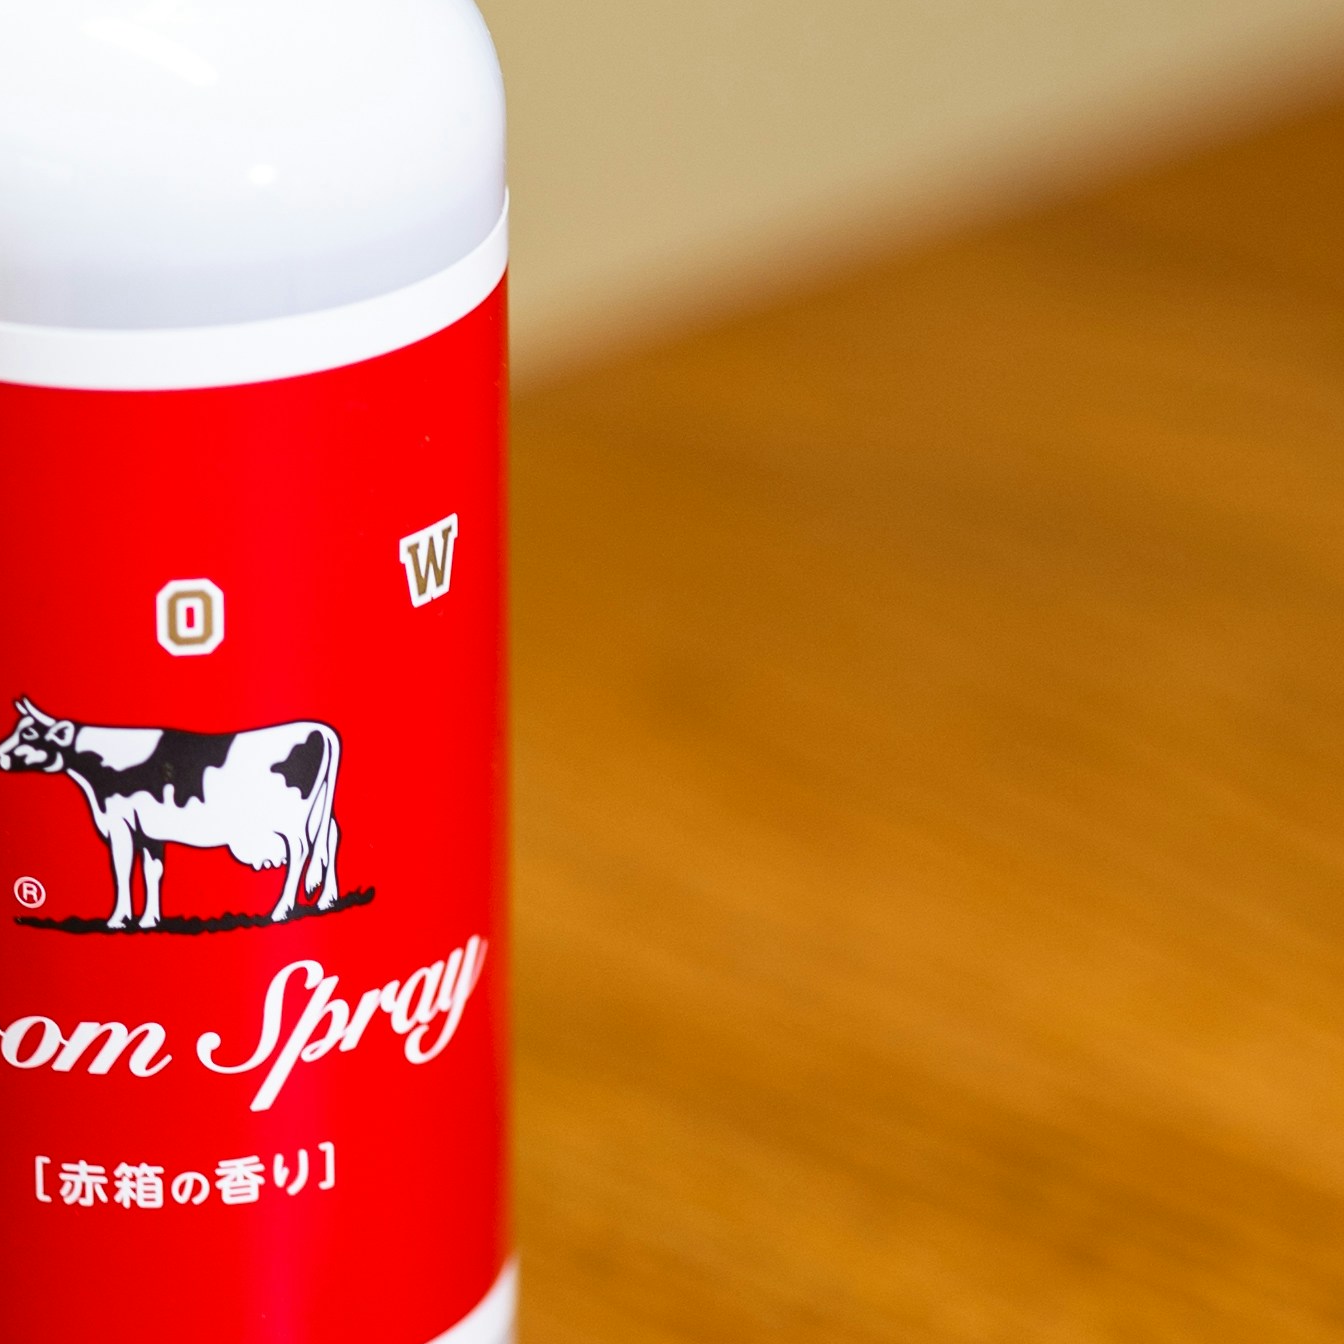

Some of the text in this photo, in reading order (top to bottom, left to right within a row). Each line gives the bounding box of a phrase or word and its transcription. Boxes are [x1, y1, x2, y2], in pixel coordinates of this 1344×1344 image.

[196, 934, 488, 1112] Spray
[35, 1141, 336, 1209] [赤箱の香り]
